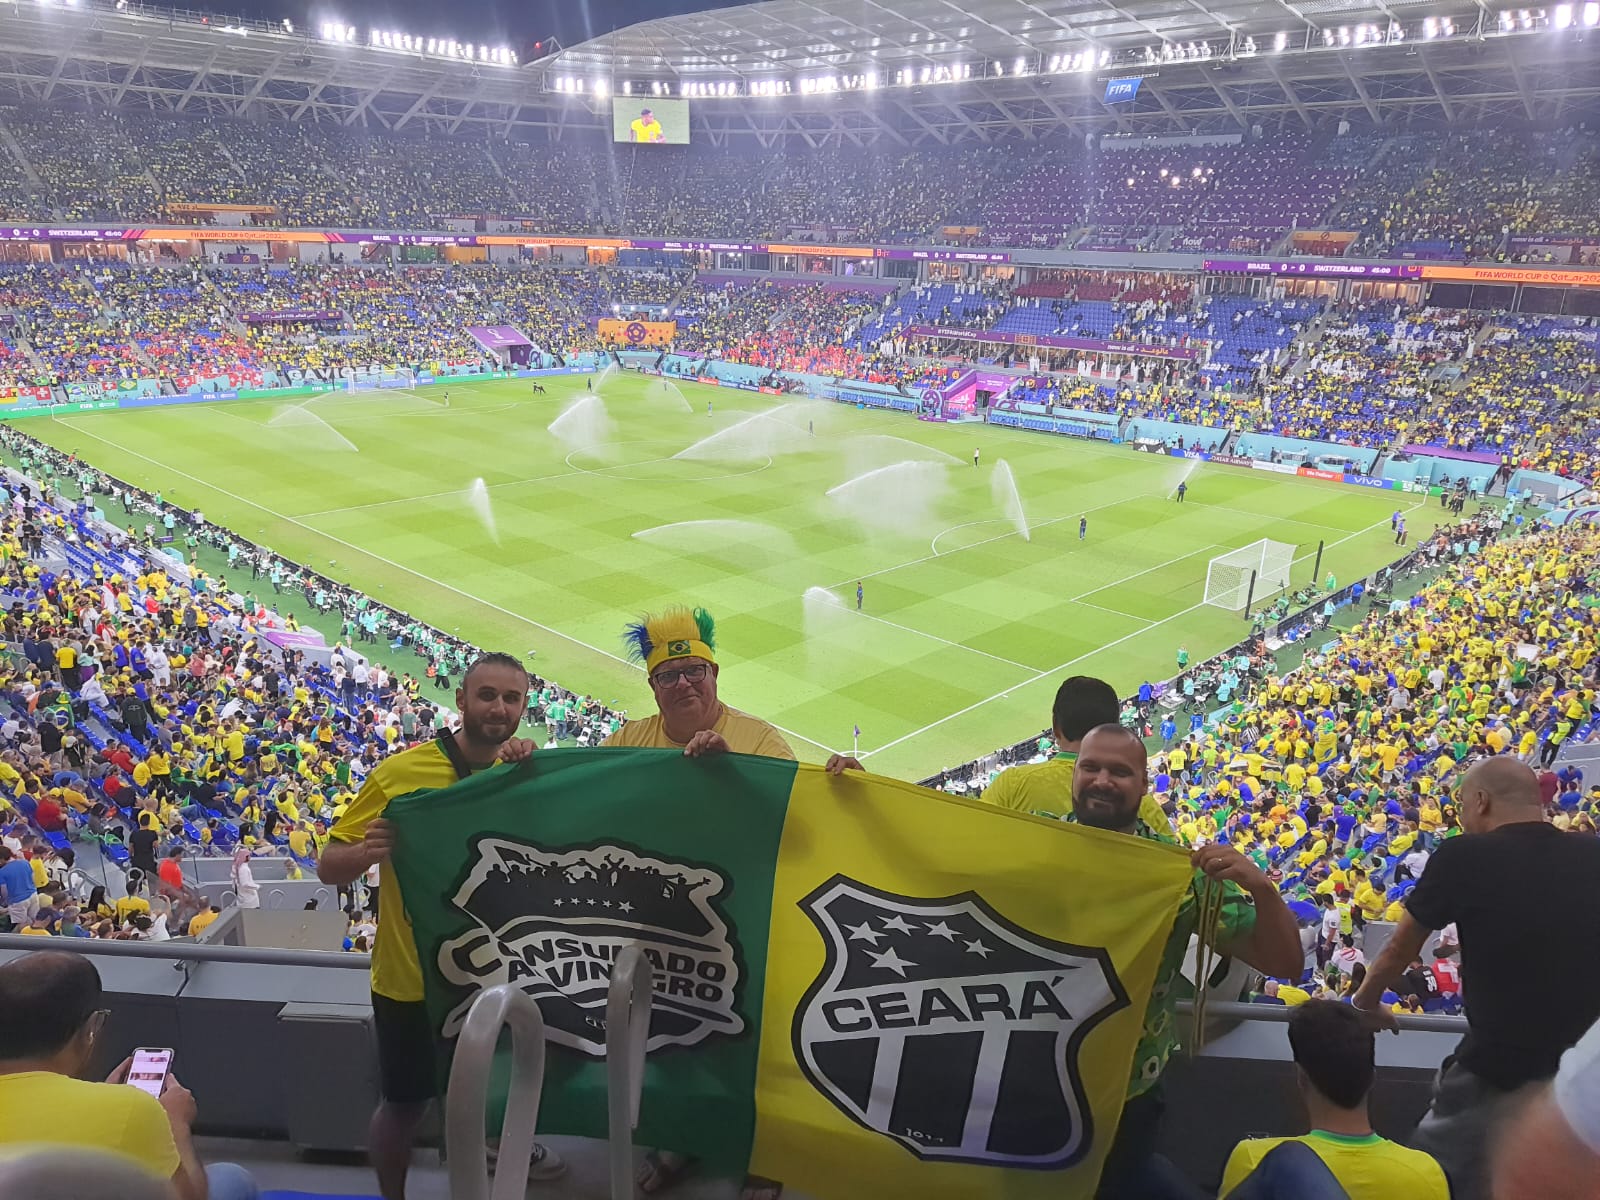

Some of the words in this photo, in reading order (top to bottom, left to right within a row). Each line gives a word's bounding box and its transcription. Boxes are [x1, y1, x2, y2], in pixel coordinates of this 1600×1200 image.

[1109, 84, 1132, 95] FIFA
[1281, 263, 1287, 271] 0
[1299, 264, 1305, 272] 0
[1314, 264, 1366, 273] SWITZERLAND
[1493, 271, 1524, 279] WORLD
[1183, 450, 1200, 458] VISA
[1212, 455, 1229, 463] QATAR
[1230, 458, 1253, 466] AIRWAYS
[1354, 476, 1382, 486] vivo
[508, 960, 723, 1002] AVINGRO
[821, 976, 1073, 1033] CEARÁ
